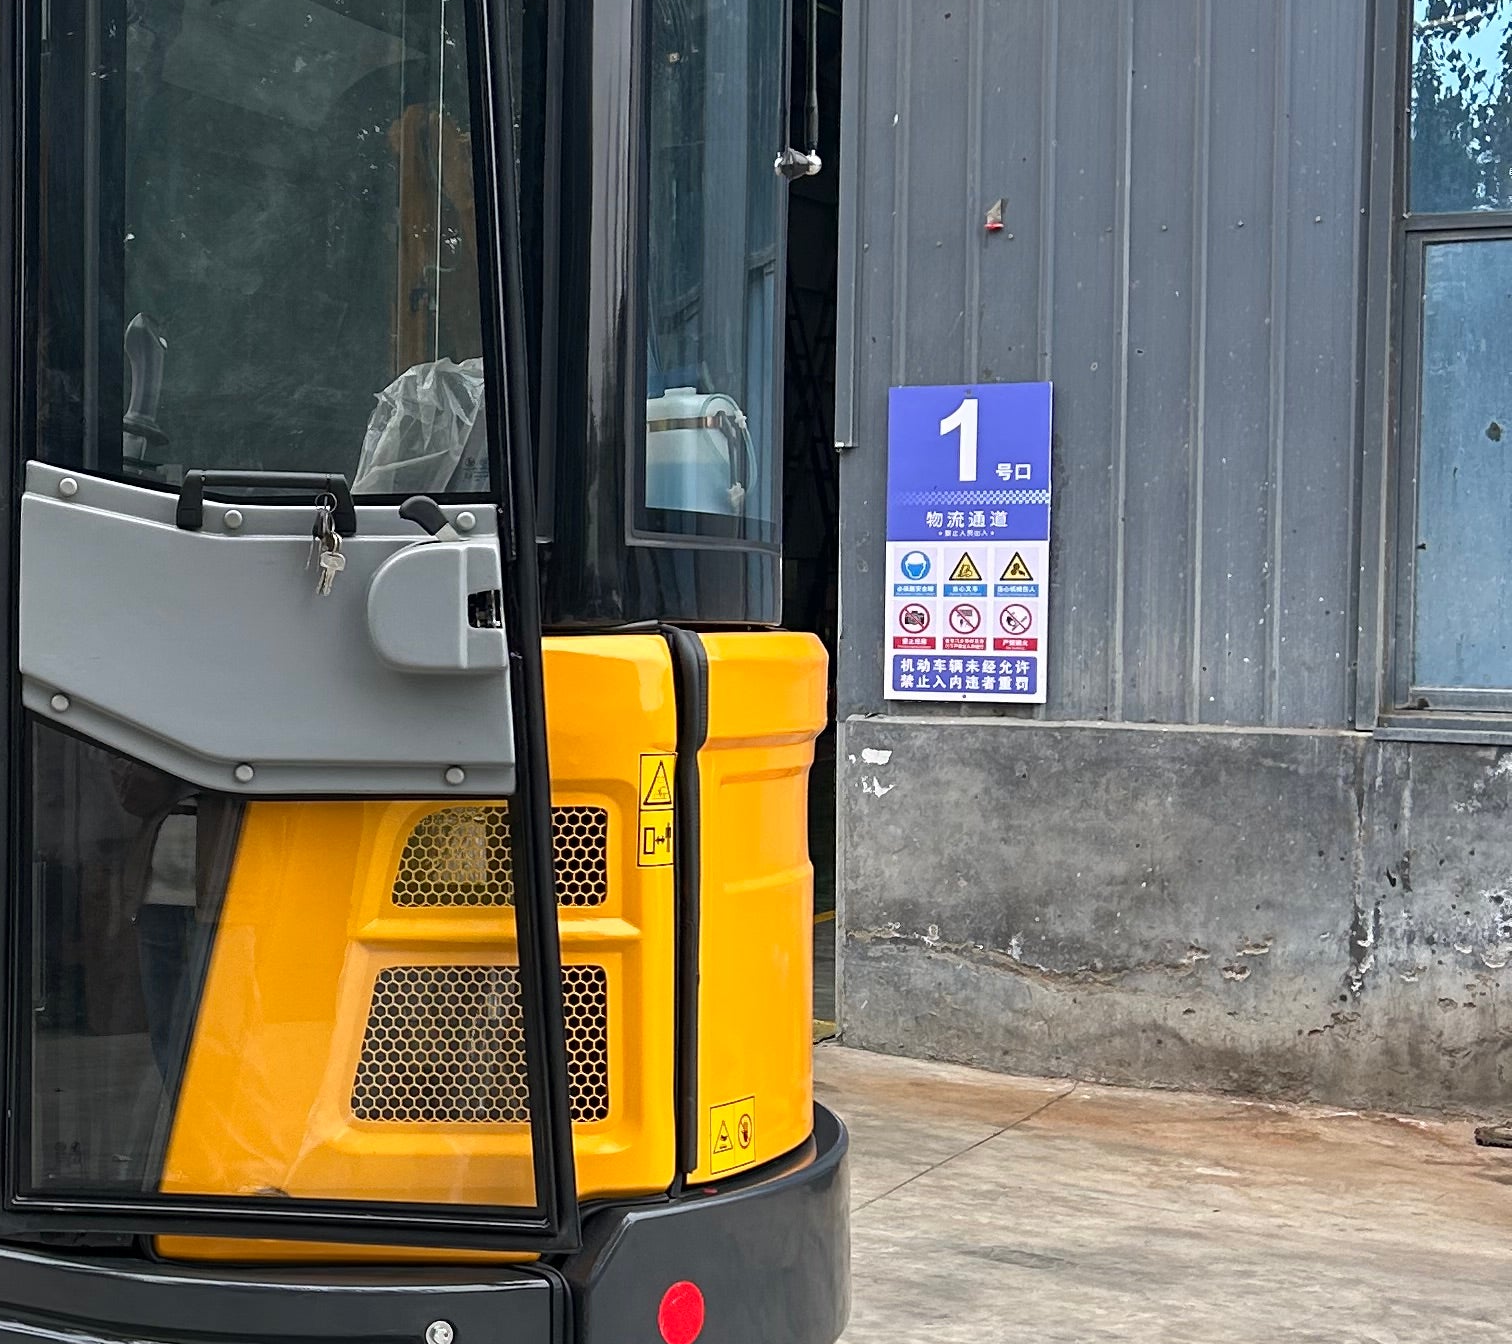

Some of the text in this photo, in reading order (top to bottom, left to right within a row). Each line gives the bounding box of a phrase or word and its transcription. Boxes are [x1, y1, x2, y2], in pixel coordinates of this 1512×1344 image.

[940, 398, 1031, 482] 1 号口
[926, 510, 1008, 528] 物流通道
[900, 658, 1030, 674] 机动车辆未经允许
